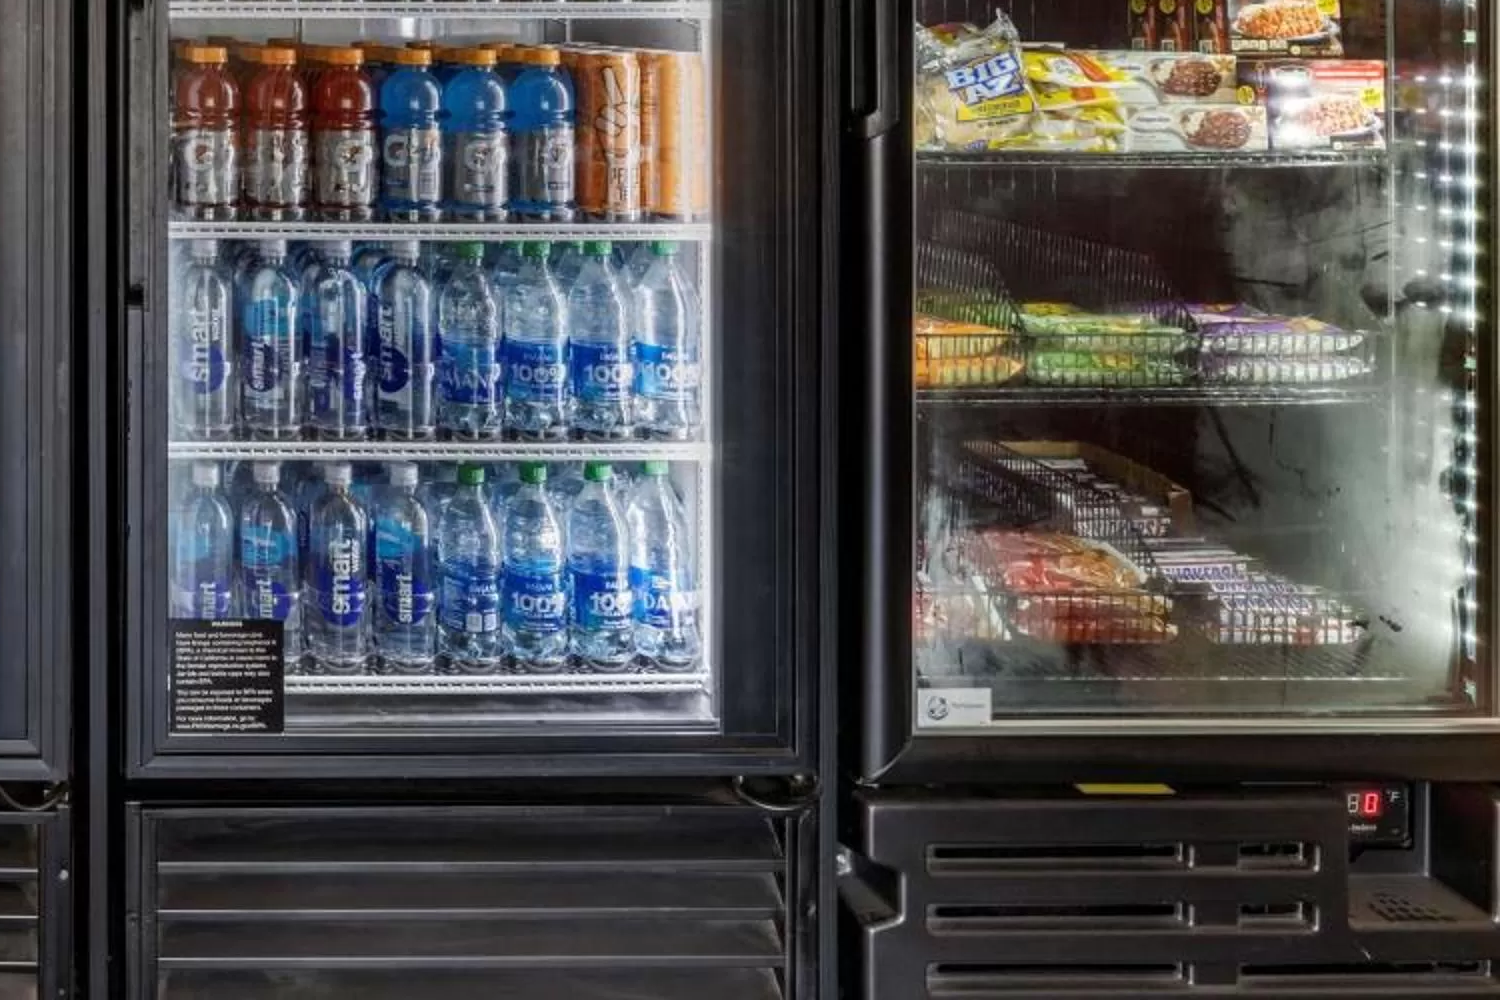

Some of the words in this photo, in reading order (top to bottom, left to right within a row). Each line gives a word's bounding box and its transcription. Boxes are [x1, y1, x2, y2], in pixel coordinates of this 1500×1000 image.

[259, 578, 273, 618] mart
[330, 539, 350, 615] smart
[398, 573, 412, 622] smart
